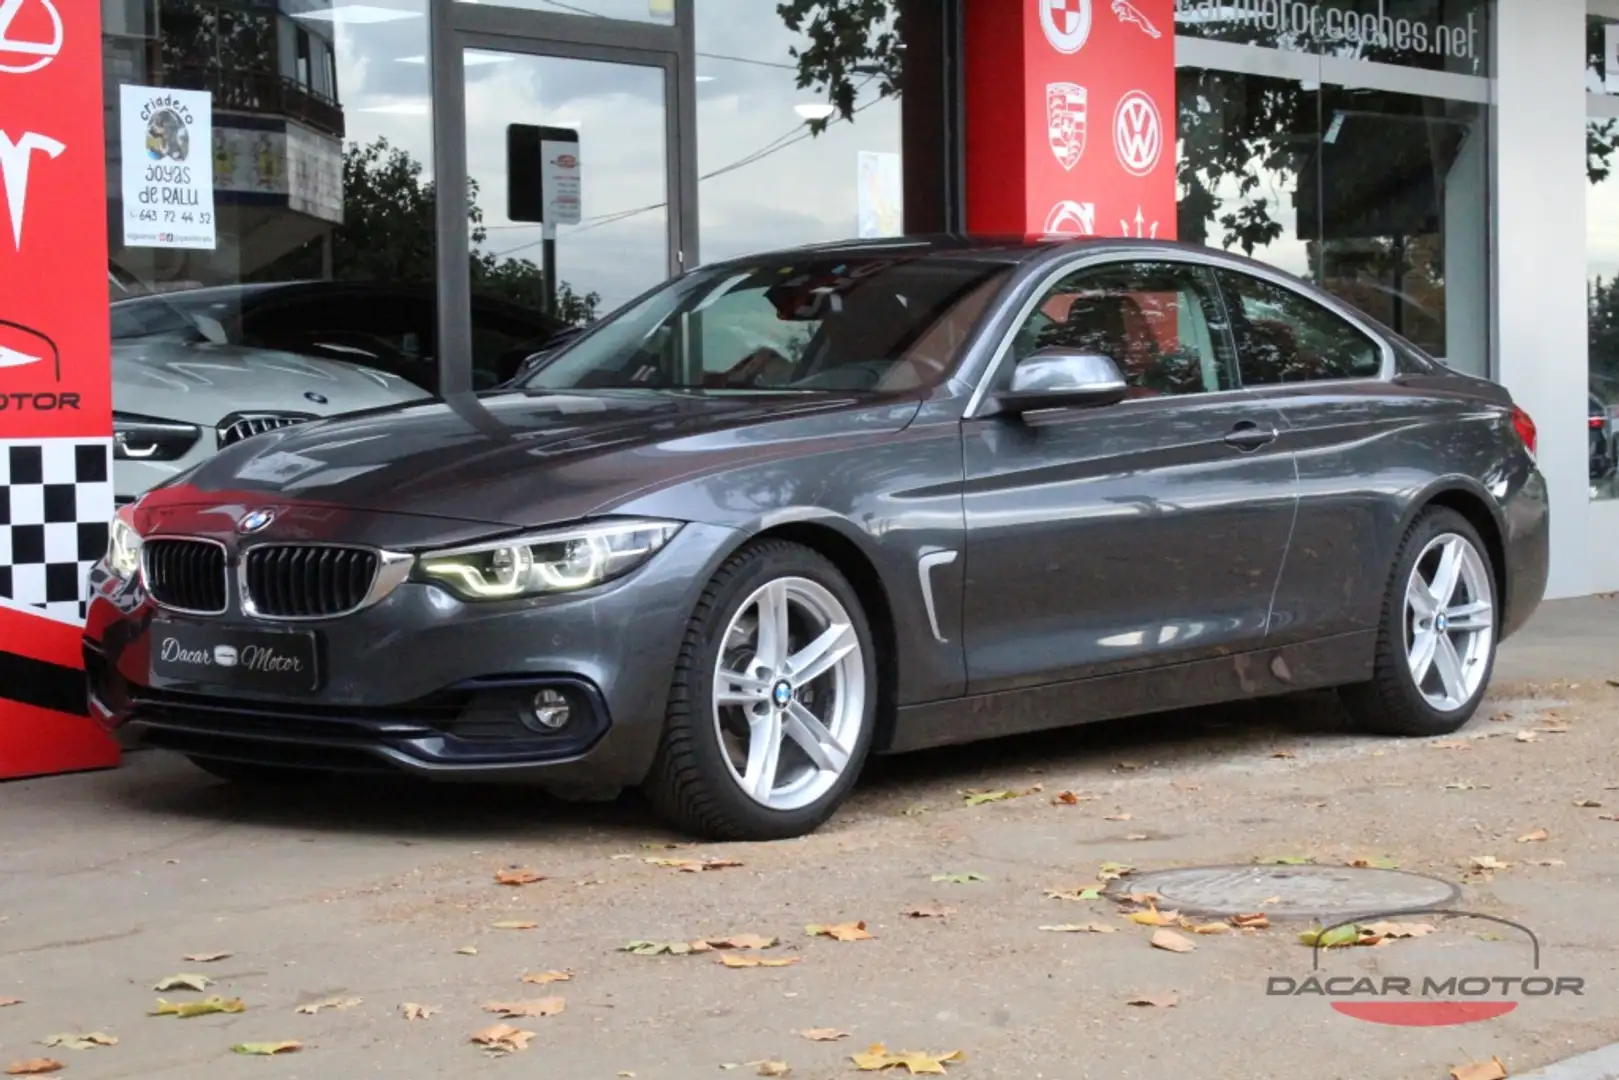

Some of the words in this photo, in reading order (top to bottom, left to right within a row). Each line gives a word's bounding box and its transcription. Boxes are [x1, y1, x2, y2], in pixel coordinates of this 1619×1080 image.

[140, 92, 193, 125] criadero
[138, 185, 158, 204] de
[162, 186, 199, 206] RALU
[163, 210, 176, 223] 72
[181, 211, 194, 224] 44
[161, 637, 212, 665] Dacar
[240, 644, 303, 672] Motor
